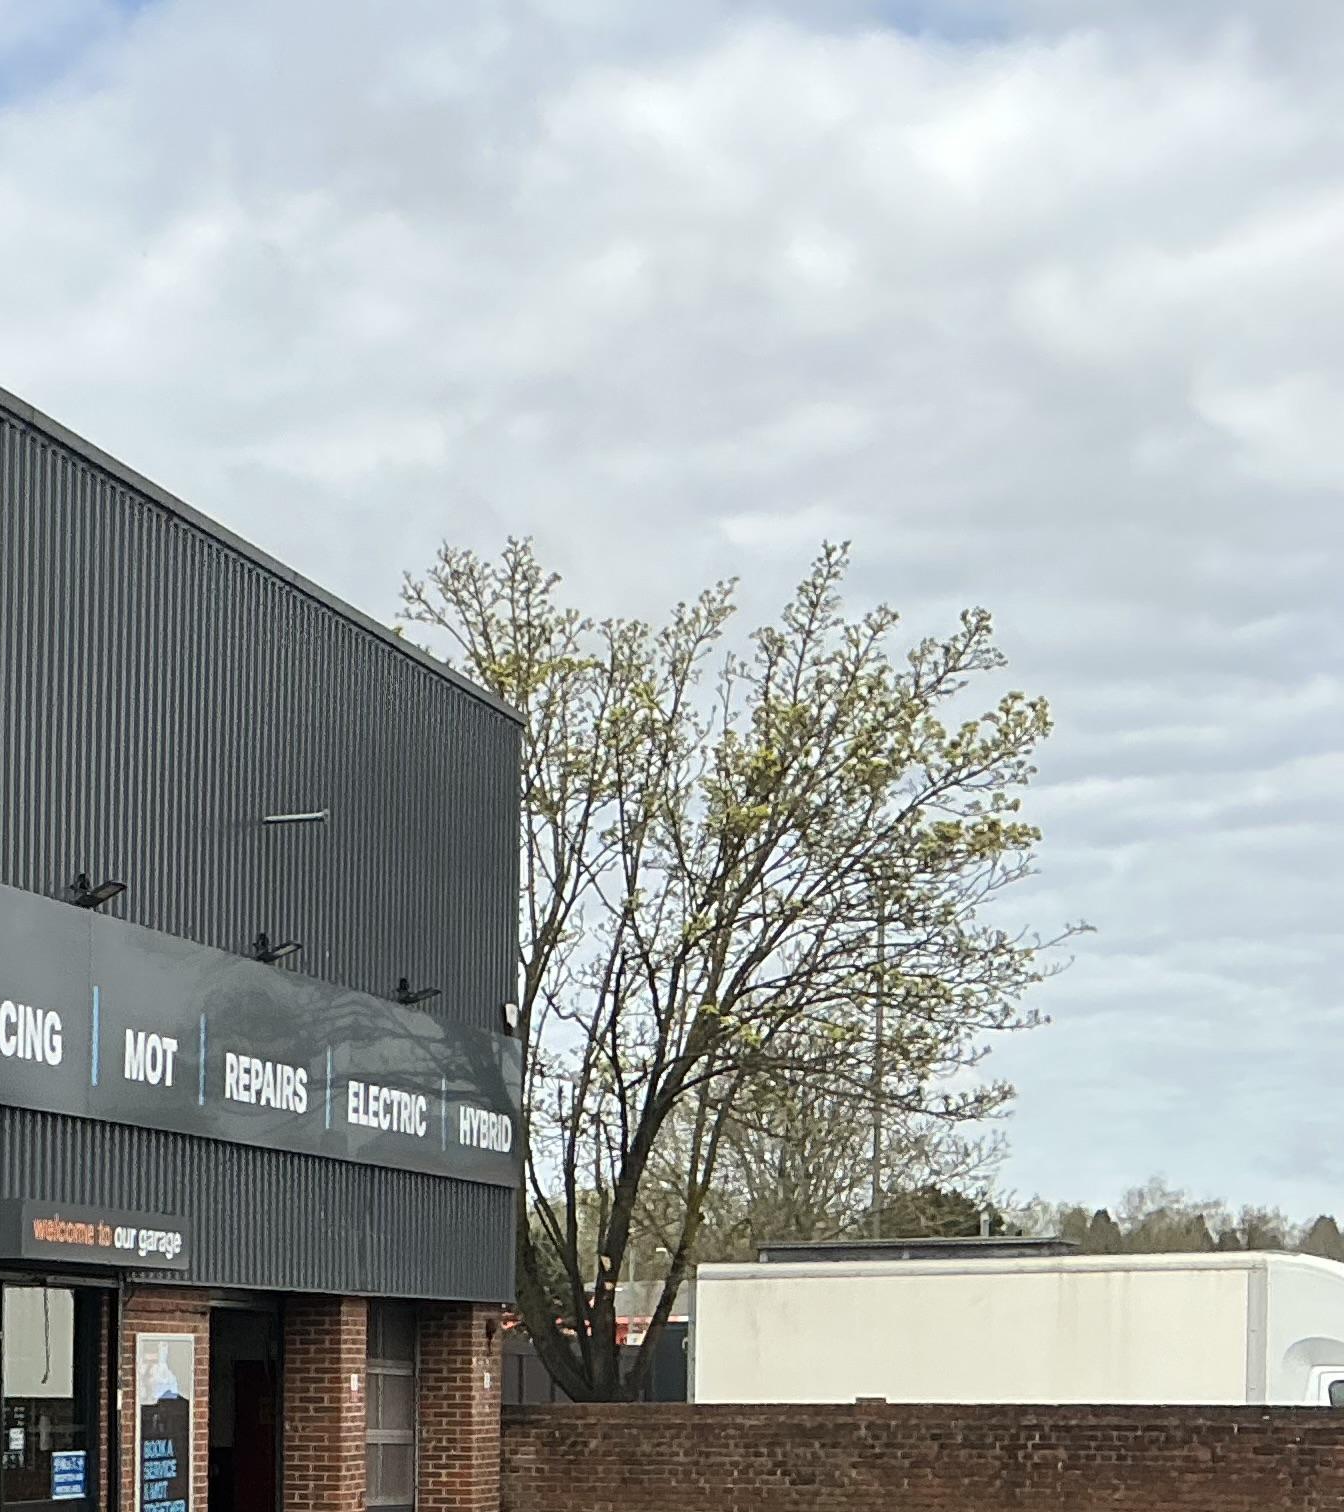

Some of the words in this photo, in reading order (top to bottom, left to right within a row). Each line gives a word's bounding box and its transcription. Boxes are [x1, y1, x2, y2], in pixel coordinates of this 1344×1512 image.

[124, 1028, 178, 1087] MOT
[224, 1052, 308, 1114] REPAIRS
[347, 1080, 427, 1138] ELECTRIC
[459, 1105, 512, 1153] HYBRID
[33, 1213, 95, 1246] welcome
[97, 1219, 111, 1247] to
[114, 1226, 137, 1249] our
[138, 1228, 182, 1260] garage
